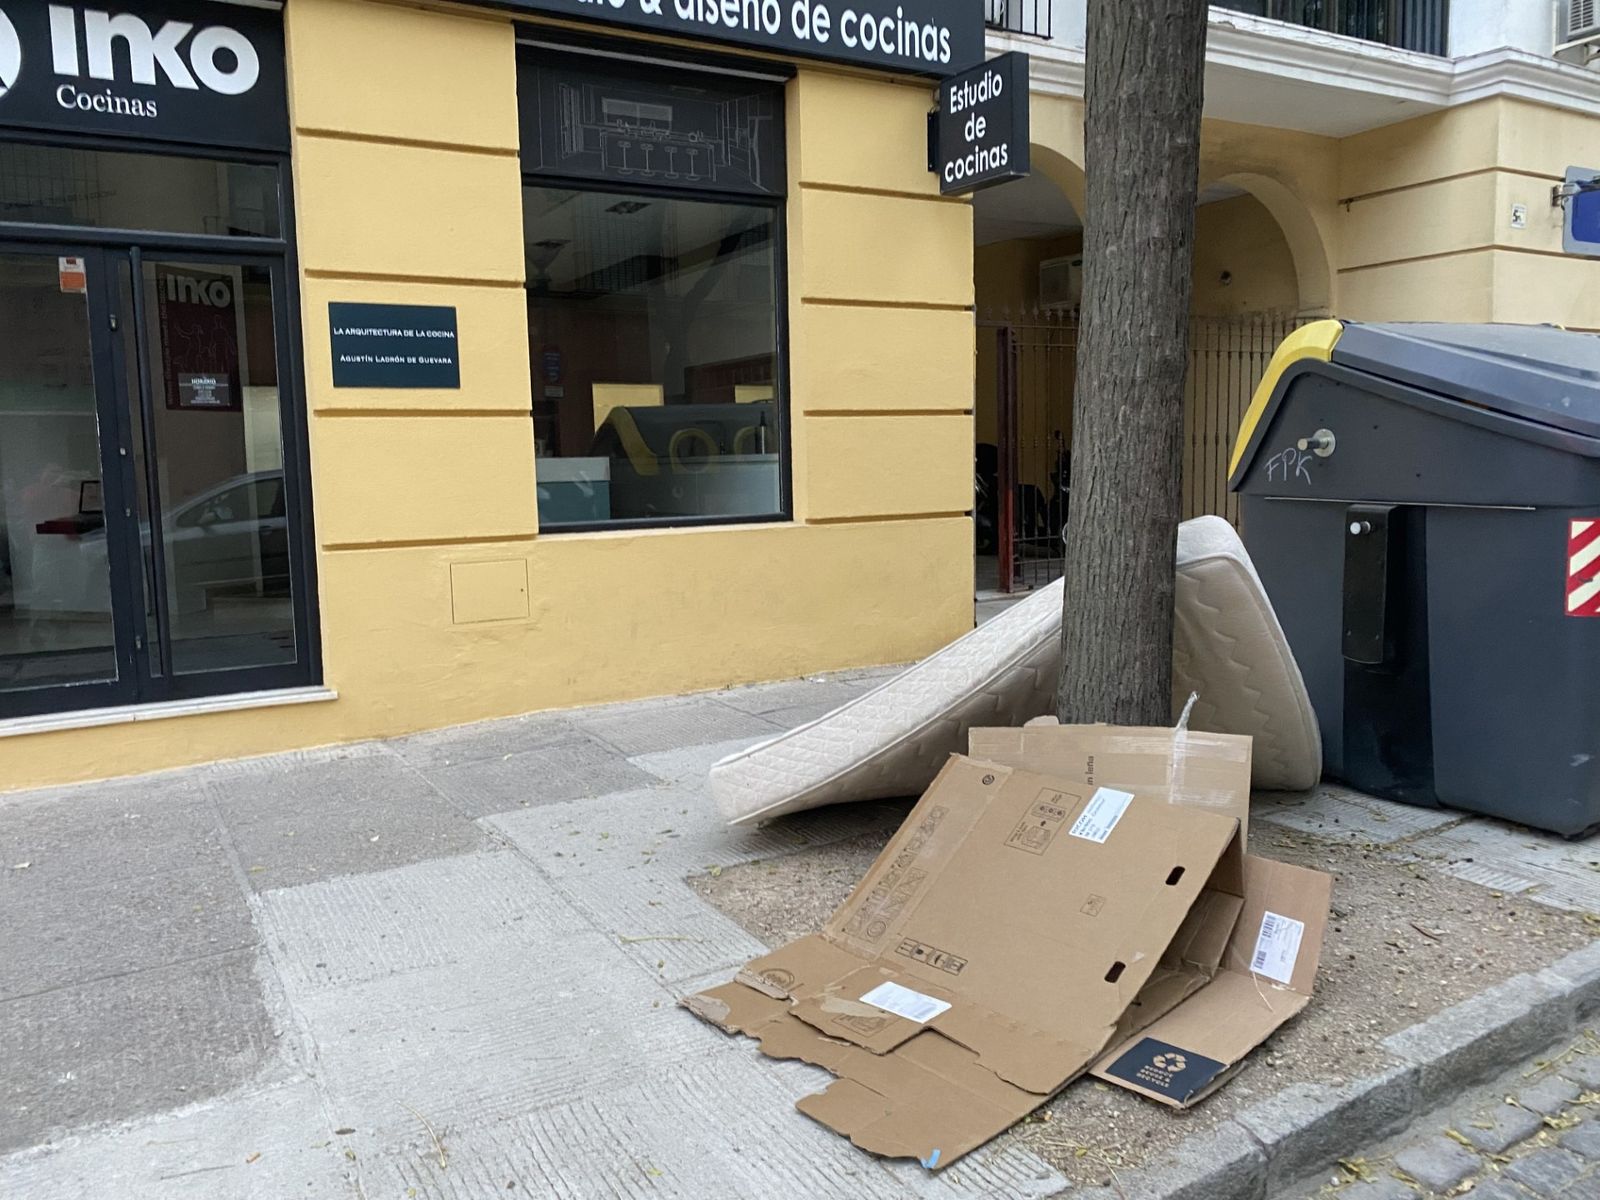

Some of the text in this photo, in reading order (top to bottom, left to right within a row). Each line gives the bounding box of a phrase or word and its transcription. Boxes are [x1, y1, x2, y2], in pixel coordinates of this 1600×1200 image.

[791, 0, 831, 43] de
[840, 6, 951, 64] cocinas
[56, 84, 158, 118] Cocinas
[950, 70, 1003, 114] Estudio
[964, 112, 986, 142] de
[944, 143, 1008, 183] cocinas
[333, 327, 455, 339] LA ARQUITECTURA DE LA COCINA
